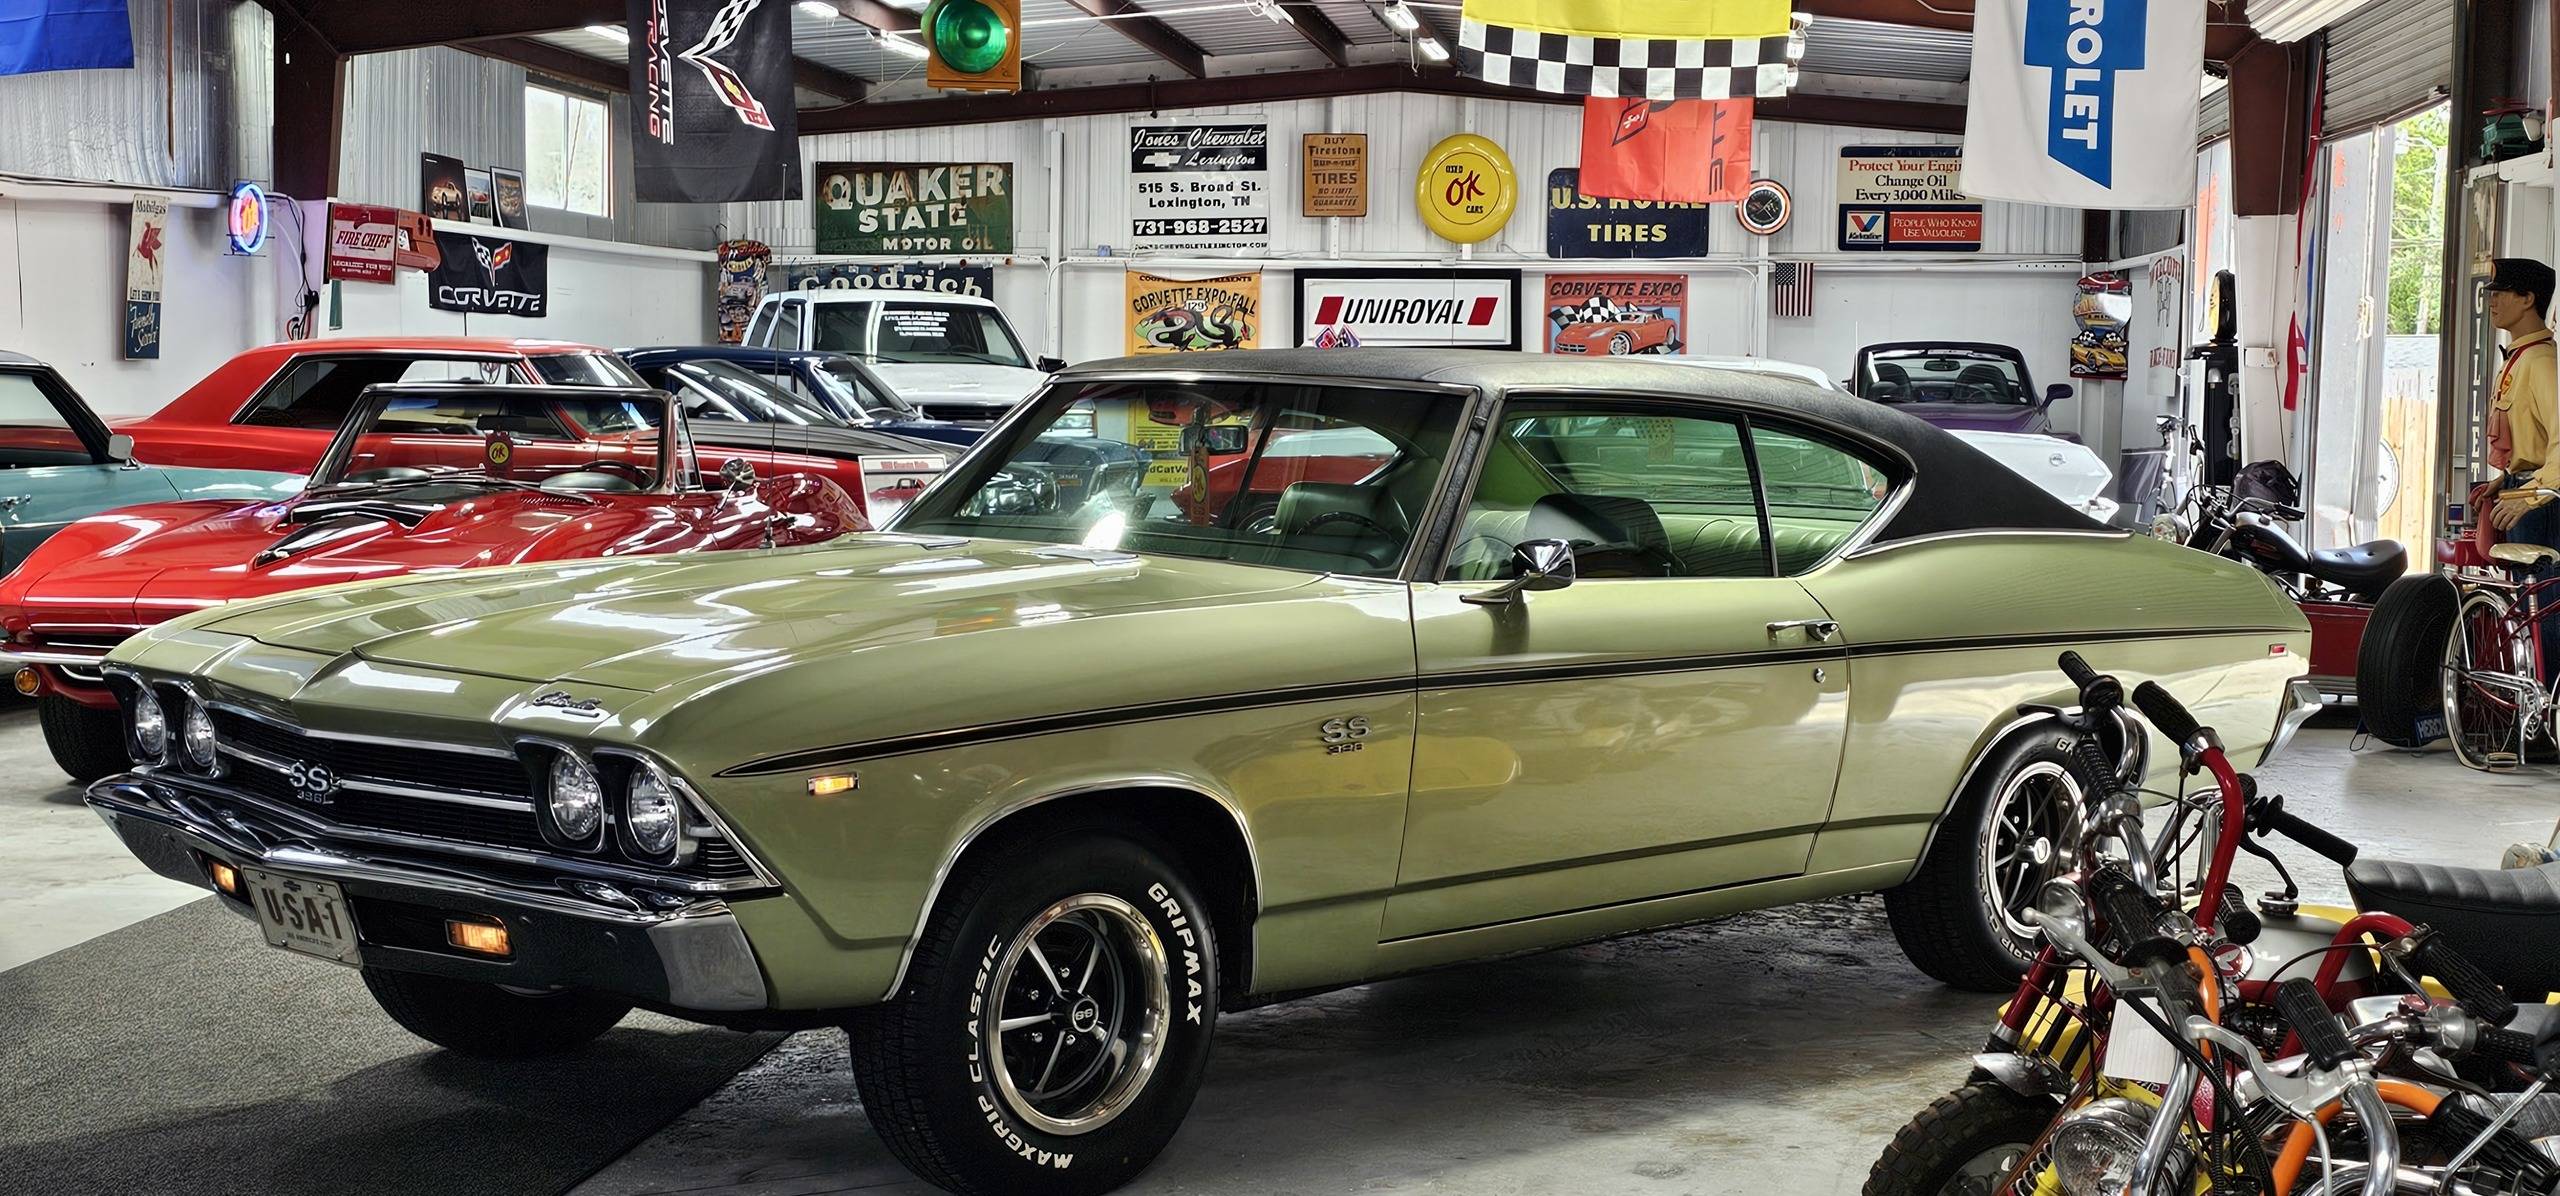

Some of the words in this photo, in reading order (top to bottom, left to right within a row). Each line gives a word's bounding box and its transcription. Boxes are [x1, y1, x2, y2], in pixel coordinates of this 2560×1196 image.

[1132, 129, 1180, 152] Jones
[1187, 127, 1266, 150] Chevrolet
[1324, 137, 1346, 145] BUY
[1308, 145, 1362, 156] Firestone
[1185, 151, 1256, 169] Lexington
[1849, 159, 1894, 172] Protect
[1897, 159, 1925, 172] Your
[1311, 172, 1358, 185] TIRES
[1445, 165, 1464, 174] USED
[822, 163, 1006, 211] QUAKER
[1138, 183, 1163, 193] 515
[1170, 182, 1184, 193] S.
[1190, 181, 1234, 193] Broad
[1241, 181, 1261, 192] St.
[1445, 170, 1486, 207] OK
[1875, 174, 1923, 188] Change
[1927, 174, 1947, 187] Oil
[1149, 197, 1226, 209] Lexington,
[1232, 196, 1251, 206] TN
[1855, 188, 1891, 203] Every
[1893, 189, 1928, 202] 3,000
[858, 202, 967, 234] STATE
[1465, 205, 1484, 214] CARS
[1134, 219, 1266, 235] 731-968-2527
[1586, 223, 1668, 243] TIRES
[335, 230, 363, 247] FIRE
[361, 232, 394, 249] CHIEF
[882, 236, 952, 251] MOTOR
[961, 236, 994, 251] OIL
[1550, 281, 1637, 296] CORVETTE
[1638, 282, 1683, 296] EXPO
[438, 285, 542, 312] CORVETTE
[1132, 287, 1193, 313] CORVETTE
[1342, 298, 1465, 325] UNIROYAL
[1322, 716, 1370, 743] SS
[289, 759, 330, 792] SS
[1147, 881, 1203, 1027] GRIPMAX
[967, 934, 1002, 1084] CLASSIC
[977, 1095, 1074, 1169] MAXGRIP
